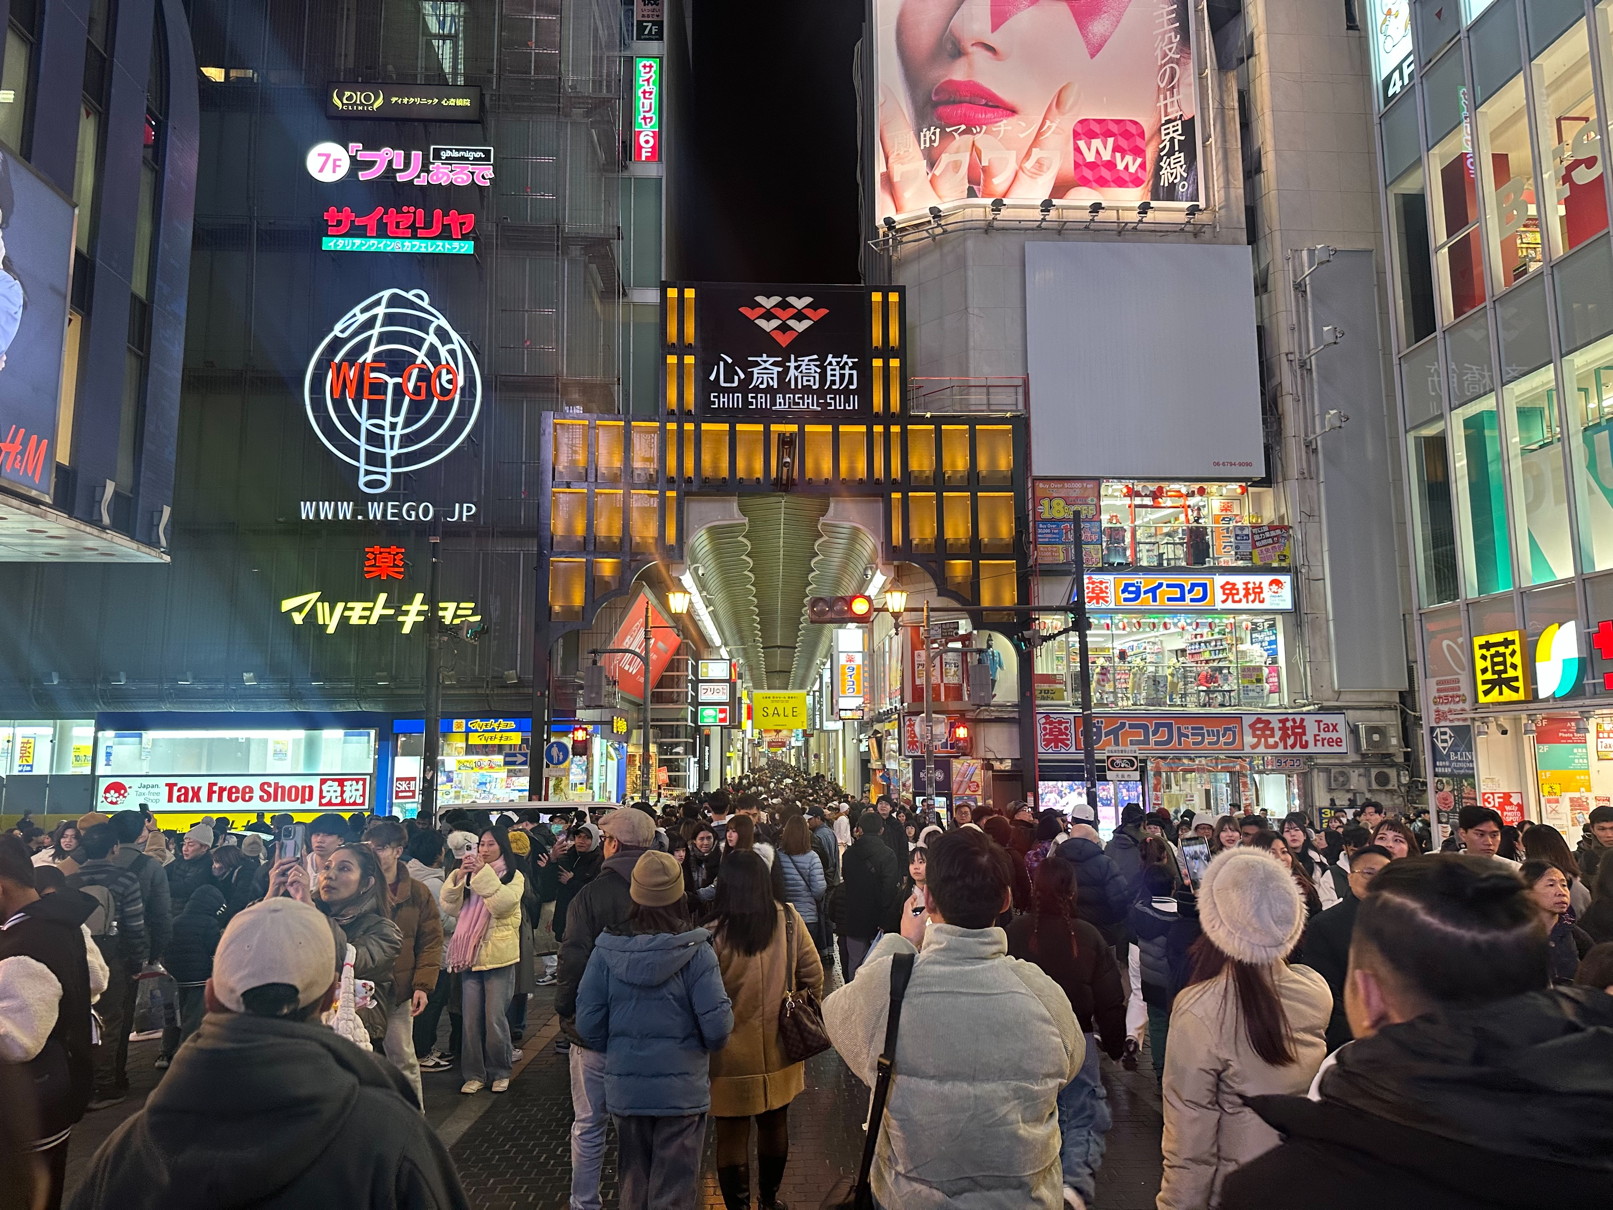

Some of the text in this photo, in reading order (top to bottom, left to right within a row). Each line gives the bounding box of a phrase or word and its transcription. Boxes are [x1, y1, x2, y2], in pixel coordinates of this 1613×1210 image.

[642, 22, 659, 35] 7F
[1387, 53, 1415, 98] 4F
[343, 91, 375, 105] DIO
[390, 96, 439, 106] ディオクリニック
[639, 61, 655, 129] サイゼリヤ
[317, 153, 342, 174] 7F
[323, 206, 475, 239] サイゼリヤ
[708, 353, 859, 390] 心斎橋筋
[0, 424, 48, 484] H&M
[364, 546, 405, 580] 薬
[1085, 576, 1265, 606] 薬 ダイコク 免税
[281, 591, 482, 634] マツモトキヨシ
[1477, 637, 1521, 698] 薬
[762, 706, 798, 717] SALE
[1536, 719, 1547, 727] 3F
[453, 719, 516, 731] 薬 マツモトキヨシ
[1039, 714, 1073, 751] 薬
[1248, 717, 1309, 750] 免税
[1314, 719, 1339, 733] Tax
[1313, 733, 1343, 748] Free
[1538, 745, 1549, 753] 2F
[164, 781, 314, 805] Tax Free Shop
[320, 780, 365, 804] 免税
[1483, 793, 1503, 807] 3F
